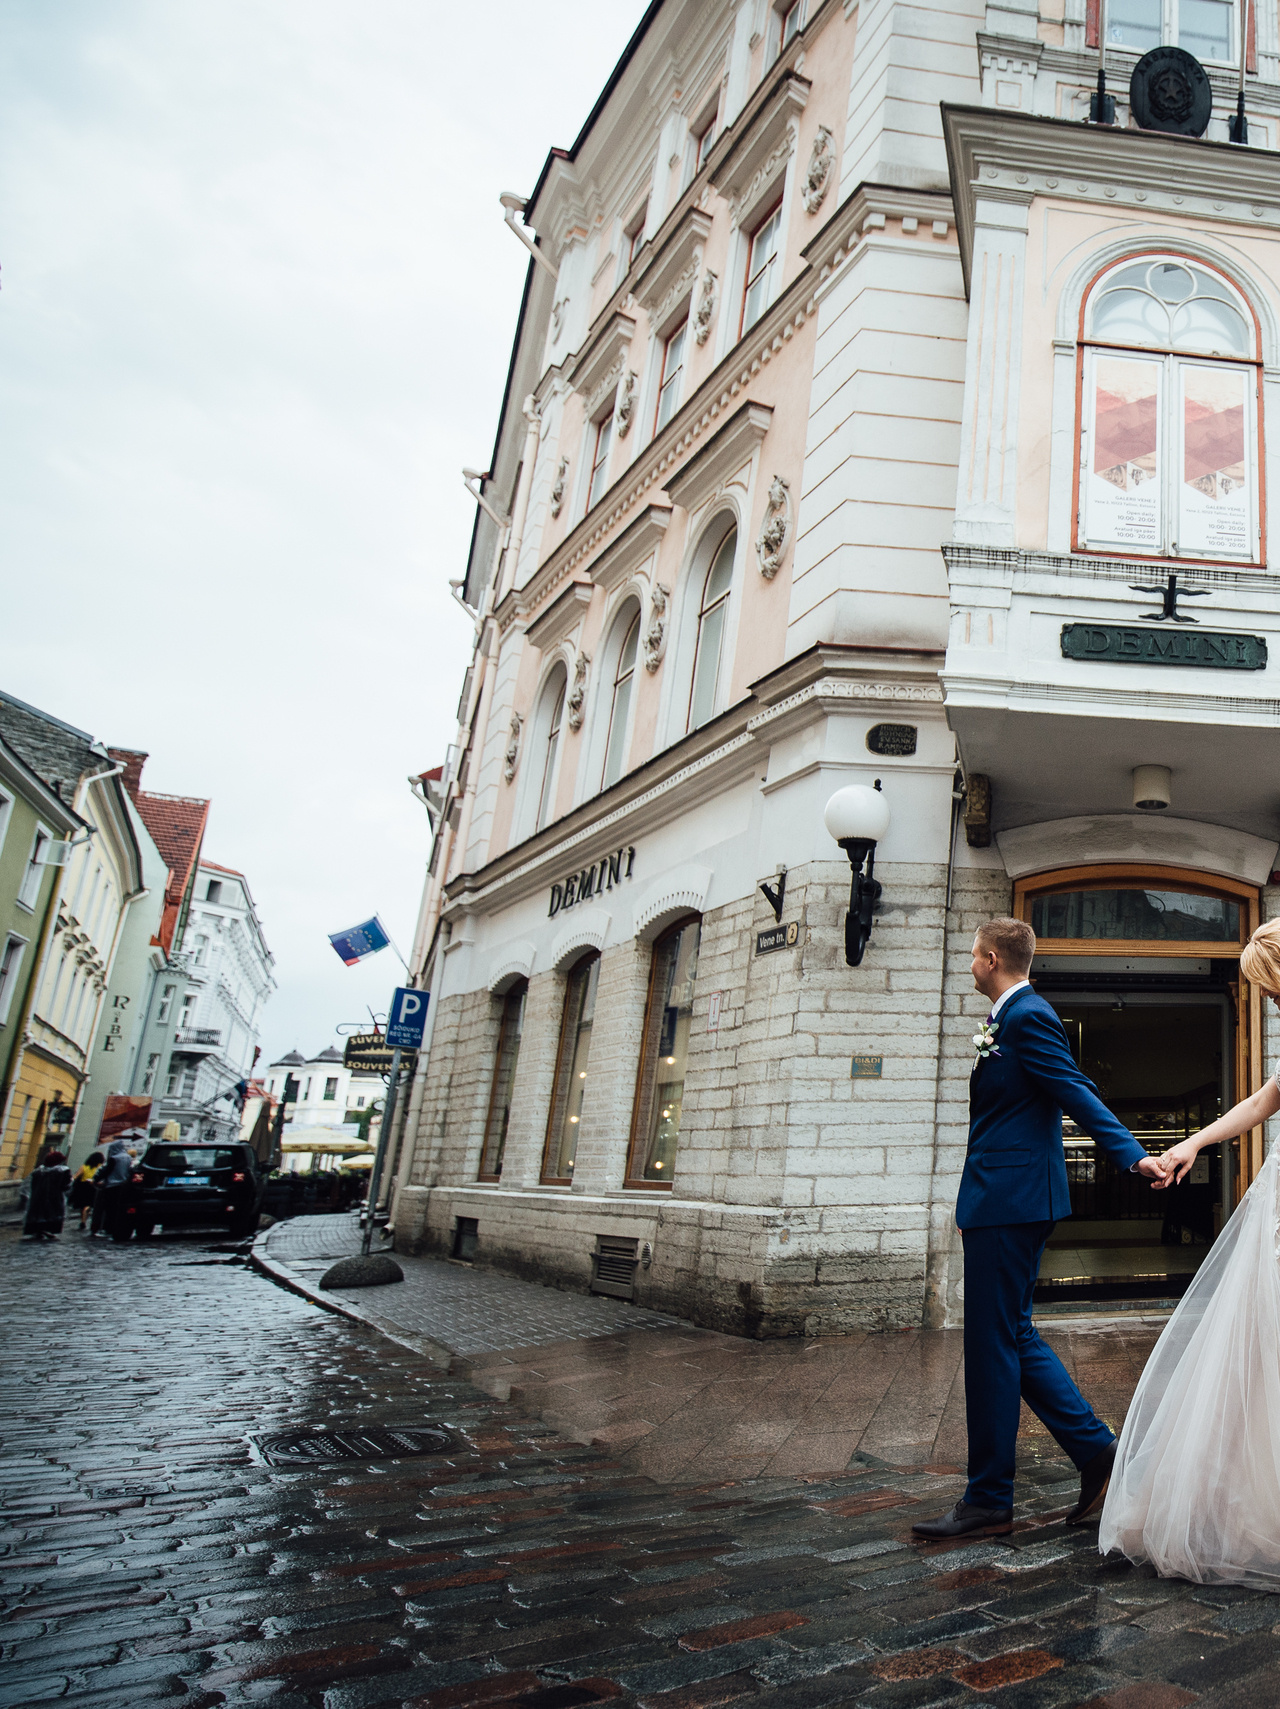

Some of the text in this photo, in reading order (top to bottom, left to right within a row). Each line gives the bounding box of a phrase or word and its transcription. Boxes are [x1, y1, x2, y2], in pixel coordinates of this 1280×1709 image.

[790, 928, 794, 938] 2
[760, 936, 775, 948] Vene
[399, 993, 421, 1024] P
[346, 1060, 410, 1070] SOUVENRS
